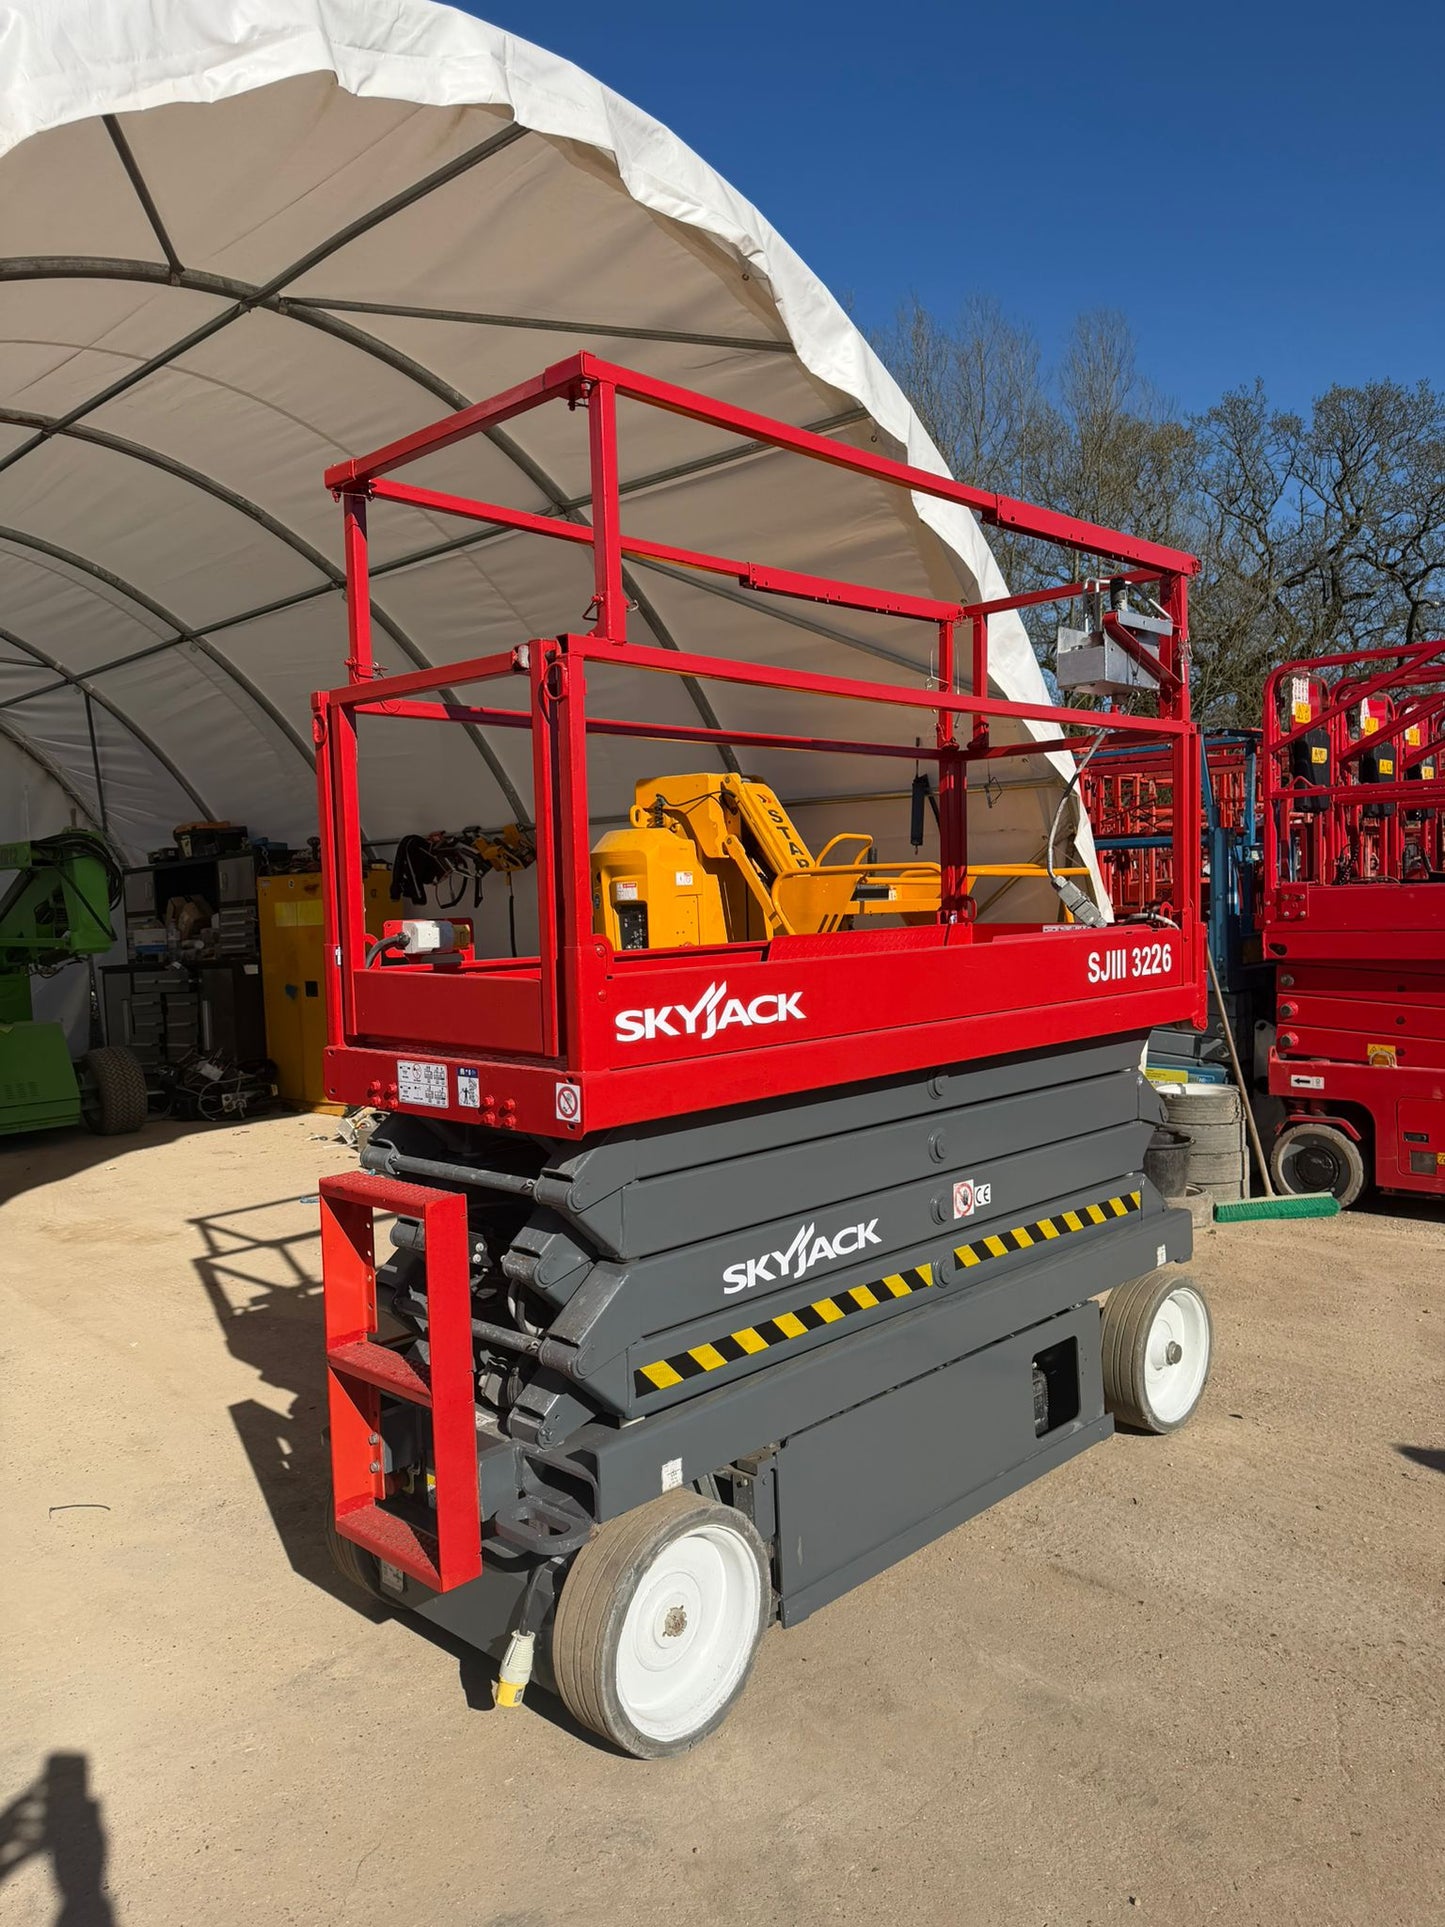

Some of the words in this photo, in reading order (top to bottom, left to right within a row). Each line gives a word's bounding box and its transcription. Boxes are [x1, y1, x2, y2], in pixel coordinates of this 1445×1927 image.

[1087, 948, 1127, 984] SJIII
[1131, 943, 1172, 977] 3226
[614, 980, 807, 1043] SKYJACK
[975, 1185, 990, 1205] CE
[722, 1217, 882, 1295] SKYJACK
